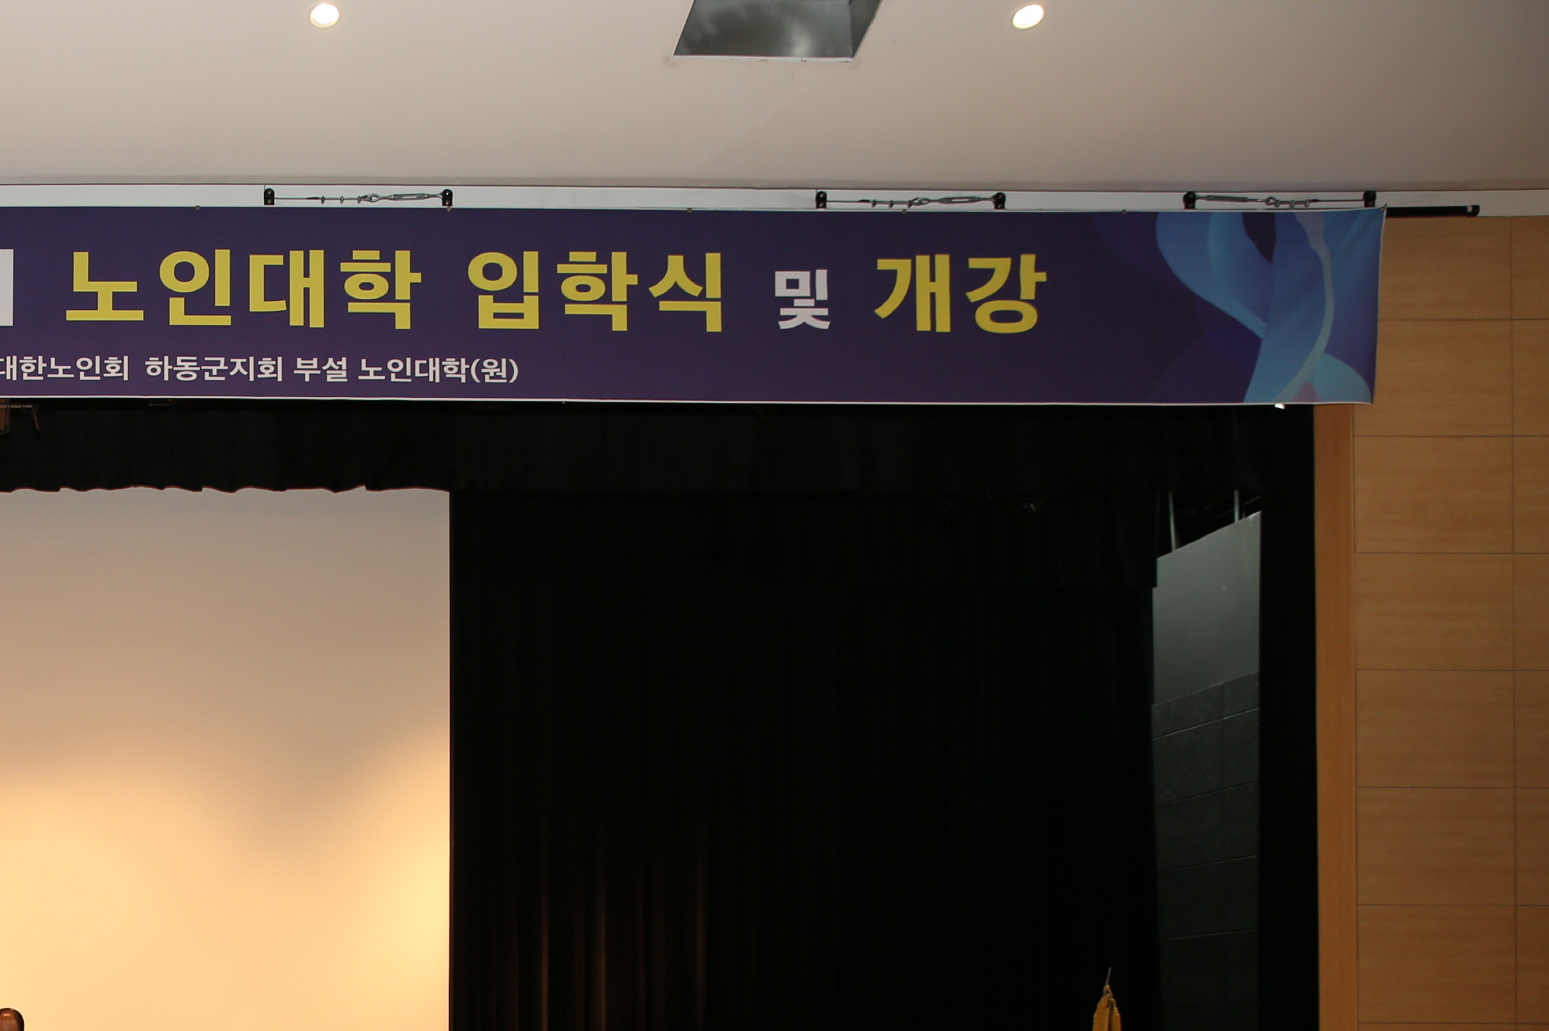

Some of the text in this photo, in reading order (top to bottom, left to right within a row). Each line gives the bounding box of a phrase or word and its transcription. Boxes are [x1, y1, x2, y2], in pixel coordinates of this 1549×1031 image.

[65, 248, 422, 330] 노인대학
[467, 250, 722, 333] 입학식
[774, 268, 831, 330] 및
[874, 253, 1047, 334] 개강
[144, 355, 283, 382] 하동군지회
[293, 356, 348, 382] 부설
[357, 357, 519, 384] 노인대학(원)
